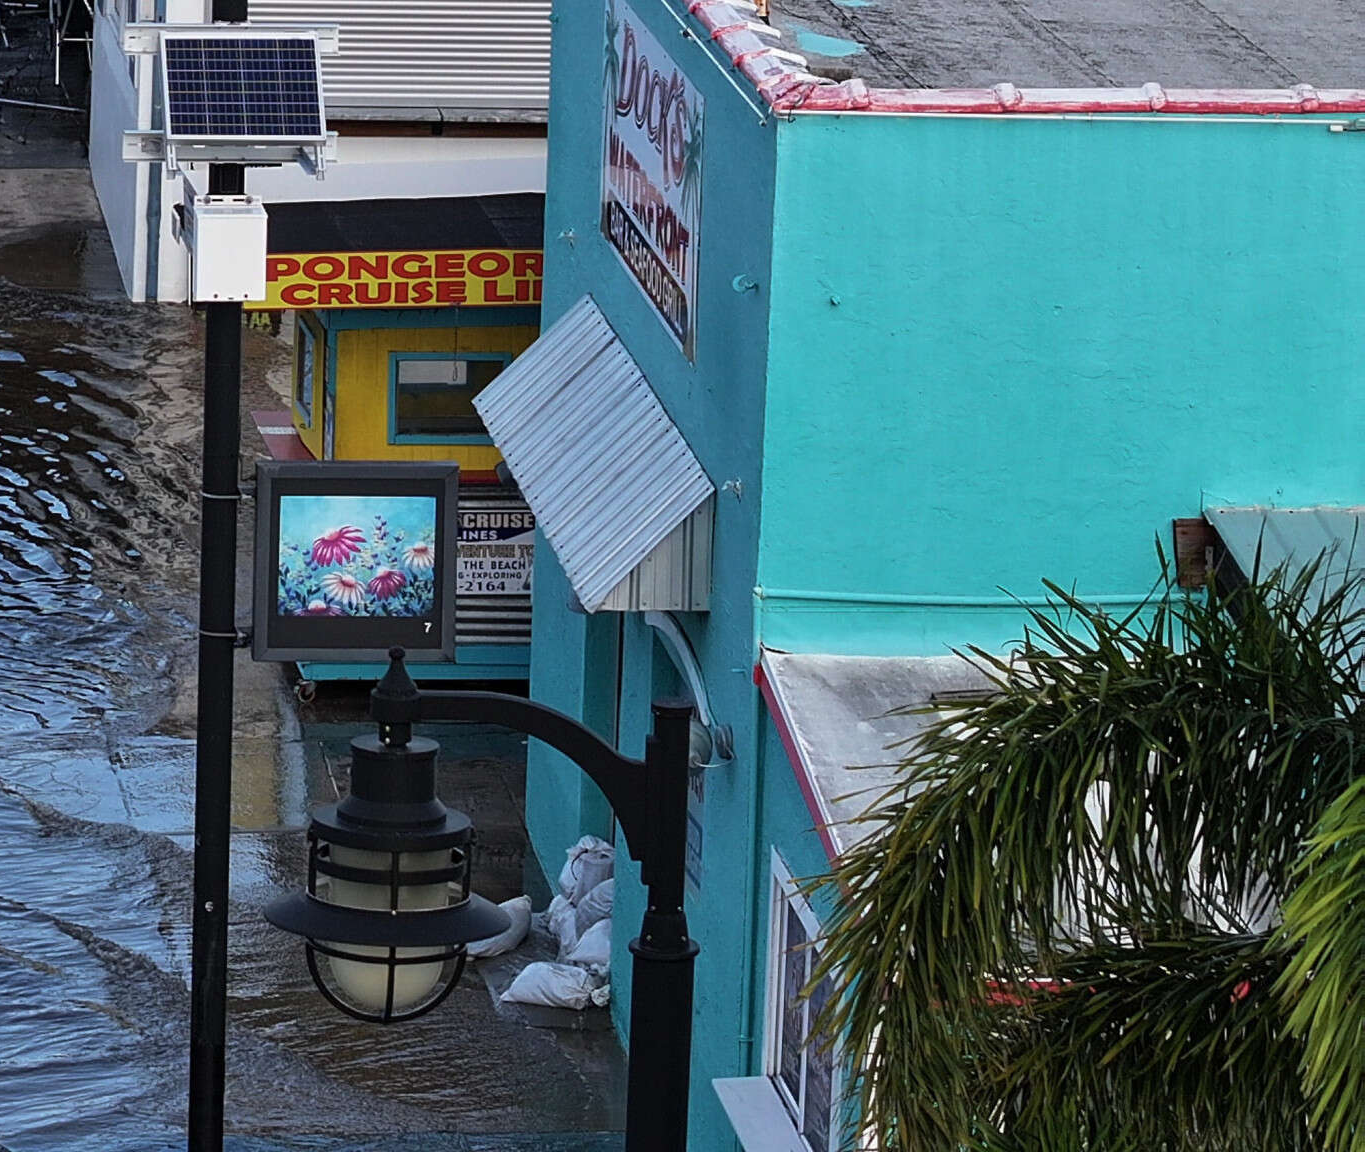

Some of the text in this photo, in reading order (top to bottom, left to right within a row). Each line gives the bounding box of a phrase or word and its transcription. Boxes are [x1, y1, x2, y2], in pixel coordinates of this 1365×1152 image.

[266, 252, 544, 282] PONGEOR
[280, 280, 468, 306] CRUISE
[463, 513, 534, 529] CRUISE
[457, 530, 498, 541] INES
[463, 560, 526, 570] THE BEACH
[471, 571, 522, 580] EXPLORING
[424, 622, 432, 634] 7
